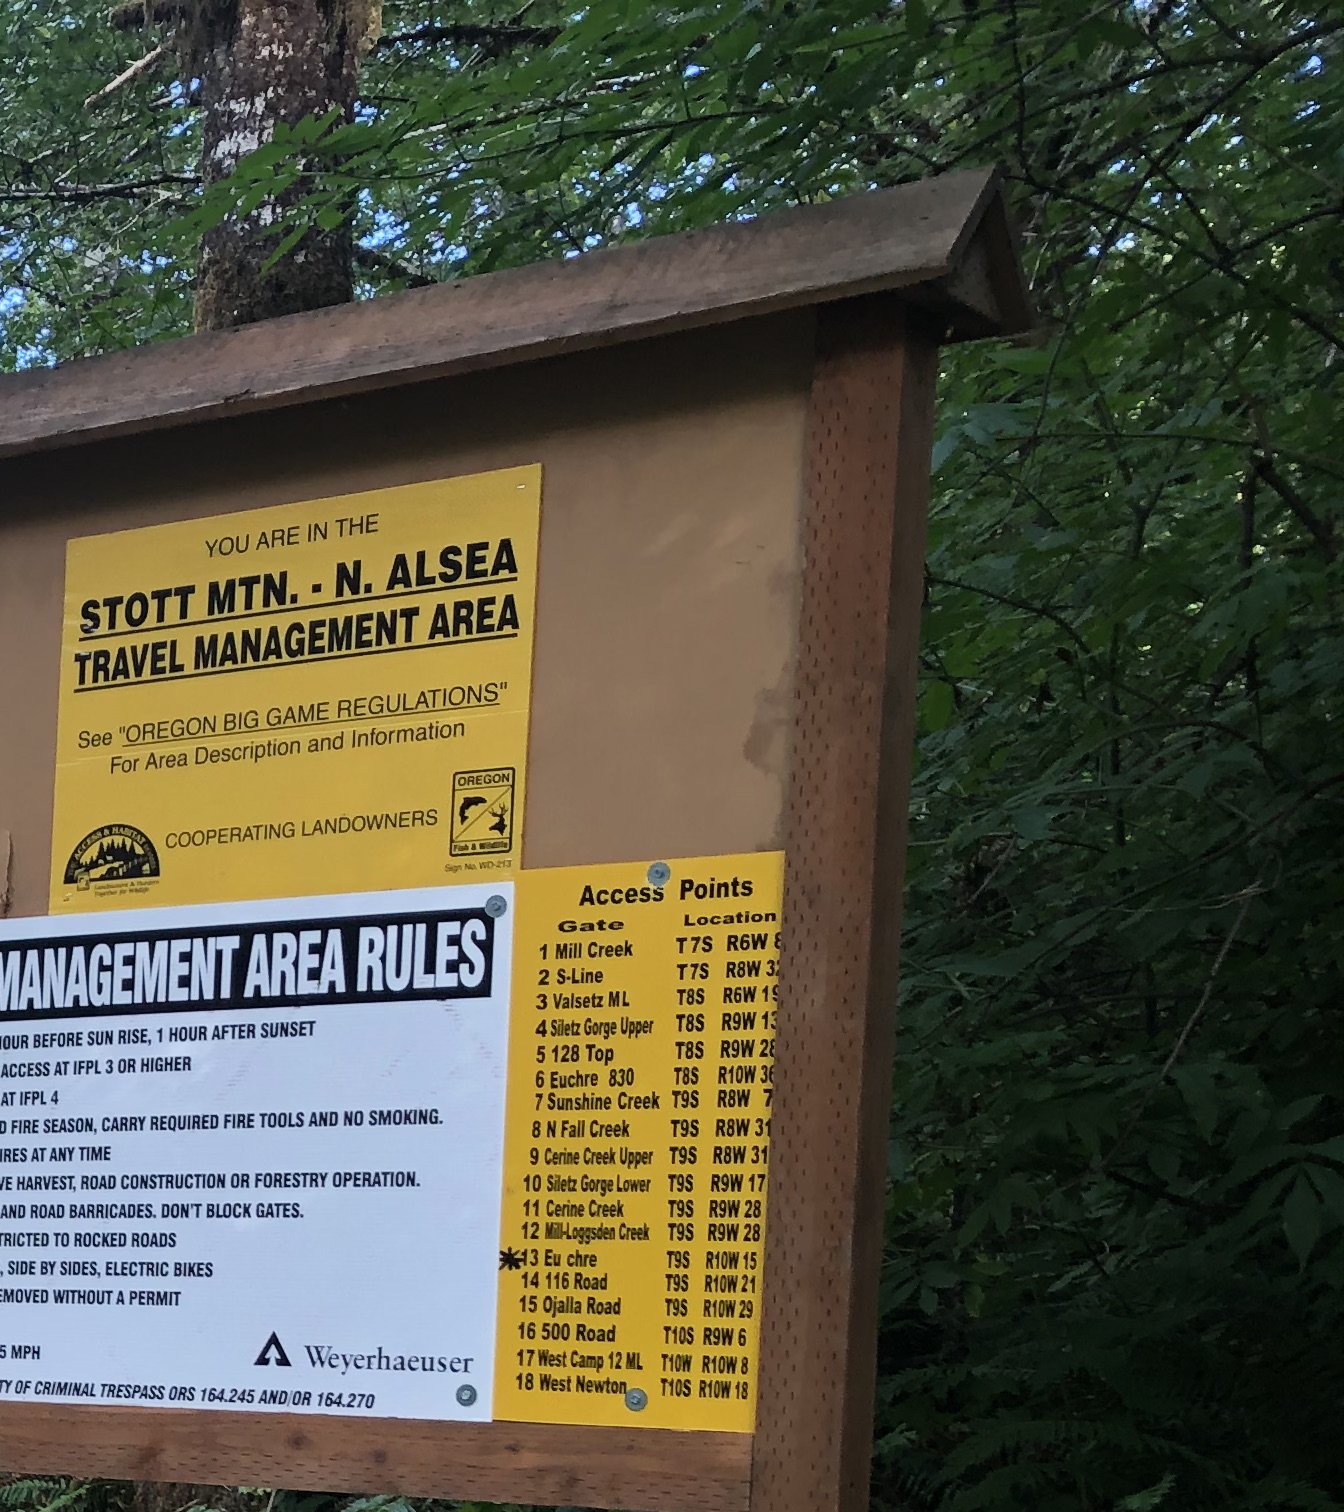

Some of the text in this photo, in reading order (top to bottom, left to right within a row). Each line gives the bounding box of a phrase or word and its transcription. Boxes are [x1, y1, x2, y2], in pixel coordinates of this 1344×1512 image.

[205, 514, 379, 558] YOU ARE IN THE
[80, 584, 196, 635] STOTT
[207, 570, 298, 617] MTN.
[335, 559, 373, 598] N.
[386, 538, 518, 592] ALSEA
[74, 594, 520, 686] TRAVEL MANAGEMENT AREA
[78, 681, 508, 749] See "OREGON BIG GAME REGULATIONS"
[110, 721, 465, 775] For Area Description and Information
[457, 773, 510, 787] OREGON
[165, 809, 438, 849] COOPERATING LANDOWNERS
[579, 878, 753, 907] Access Points
[558, 911, 777, 932] Gate Location
[243, 929, 346, 998] AREA
[357, 918, 487, 992] RULES
[33, 1032, 83, 1049] BEFORE
[87, 1030, 114, 1046] SUN
[118, 1028, 152, 1045] RISE,
[157, 1028, 163, 1043] 1
[169, 1026, 208, 1042] HOUR
[211, 1023, 256, 1041] AFTER
[260, 1021, 316, 1039] SUNSET
[0, 1062, 51, 1078] ACCESS
[54, 1061, 70, 1076] AT
[73, 1060, 102, 1075] IFPL
[105, 1059, 114, 1074] 3
[118, 1058, 136, 1074] OR
[141, 1056, 191, 1073] HIGHER
[11, 1119, 40, 1134] FIRE
[43, 1117, 97, 1134] SEASON,
[102, 1116, 146, 1132] CARRY
[150, 1114, 219, 1132] REQUIRED
[223, 1113, 255, 1129] FIRE
[259, 1112, 305, 1128] TOOLS
[308, 1111, 339, 1127] AND
[343, 1110, 364, 1127] NO
[368, 1108, 443, 1126] SMOKING.
[530, 1146, 768, 1167] 9 Cerine Creek Upper T9S R8W 31
[0, 1204, 26, 1219] AND
[30, 1204, 65, 1219] ROAD
[69, 1203, 157, 1219] BARRICADES.
[161, 1203, 203, 1219] DON'T
[206, 1203, 252, 1219] BLOCK
[256, 1203, 304, 1219] GATES.
[523, 1199, 762, 1219] 11 Cerine Creek T9S R9W 28
[53, 1232, 70, 1248] TO
[74, 1232, 127, 1248] ROCKED
[131, 1232, 177, 1248] ROADS
[666, 1250, 690, 1269] T9S
[706, 1251, 740, 1270] R10W
[743, 1252, 757, 1271] 15
[521, 1271, 756, 1294] 14 116 Road T9S R10W 21
[519, 1295, 754, 1319] 15 Ojalla Road T9S R10W 29
[518, 1322, 747, 1347] 16 500 Road T10S R9W 6
[11, 1345, 41, 1360] MPH
[304, 1345, 474, 1373] Weyerhaeuser
[15, 1380, 32, 1395] OF
[34, 1381, 96, 1397] CRIMINAL
[100, 1383, 166, 1400] TRESPASS
[168, 1386, 196, 1402] ORS
[201, 1387, 255, 1404] 164.245
[318, 1392, 375, 1409] 164.270
